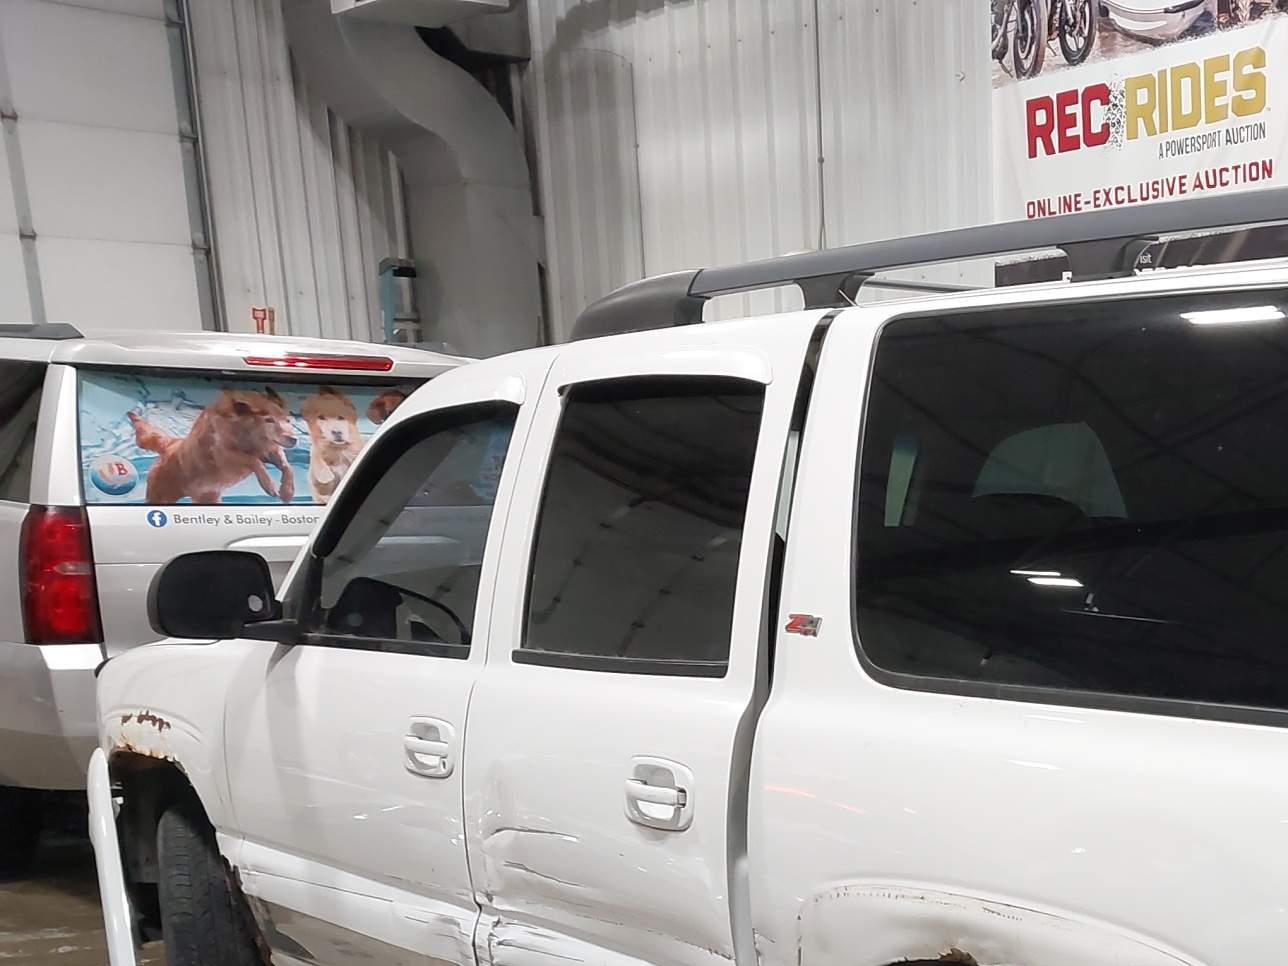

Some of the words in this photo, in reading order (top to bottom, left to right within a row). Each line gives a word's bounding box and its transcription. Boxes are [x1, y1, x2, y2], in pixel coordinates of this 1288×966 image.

[1026, 82, 1111, 159] REC
[1124, 46, 1266, 141] RIDES
[1158, 142, 1164, 160] A
[1165, 130, 1222, 157] POWERSPORT
[1225, 121, 1266, 146] AUCTION
[1027, 173, 1188, 219] ONLINE-EXCLUSIVE
[1192, 159, 1273, 191] AUCTION
[174, 514, 219, 527] Bentley
[224, 515, 233, 524] &
[236, 514, 272, 527] Bailey
